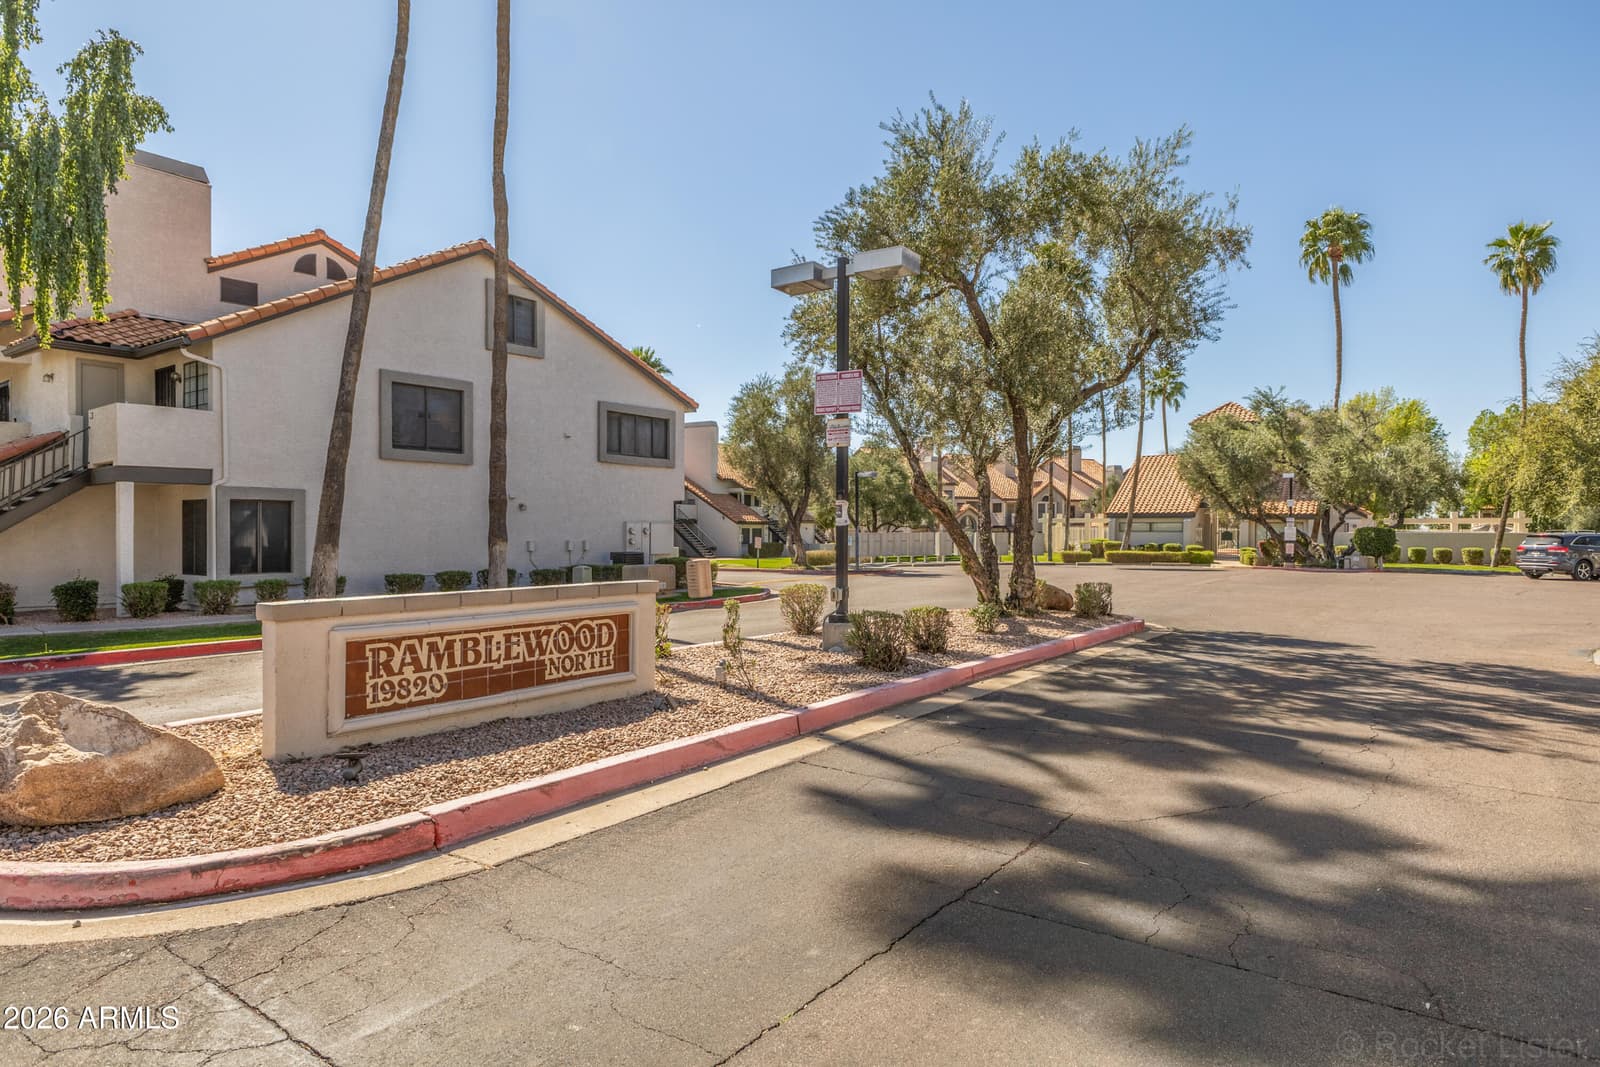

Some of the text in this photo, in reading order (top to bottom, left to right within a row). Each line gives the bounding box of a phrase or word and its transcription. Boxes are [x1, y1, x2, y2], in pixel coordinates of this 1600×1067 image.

[367, 620, 616, 680] RAMBLEWOOD
[546, 649, 614, 679] NORTH
[367, 674, 447, 706] 19820
